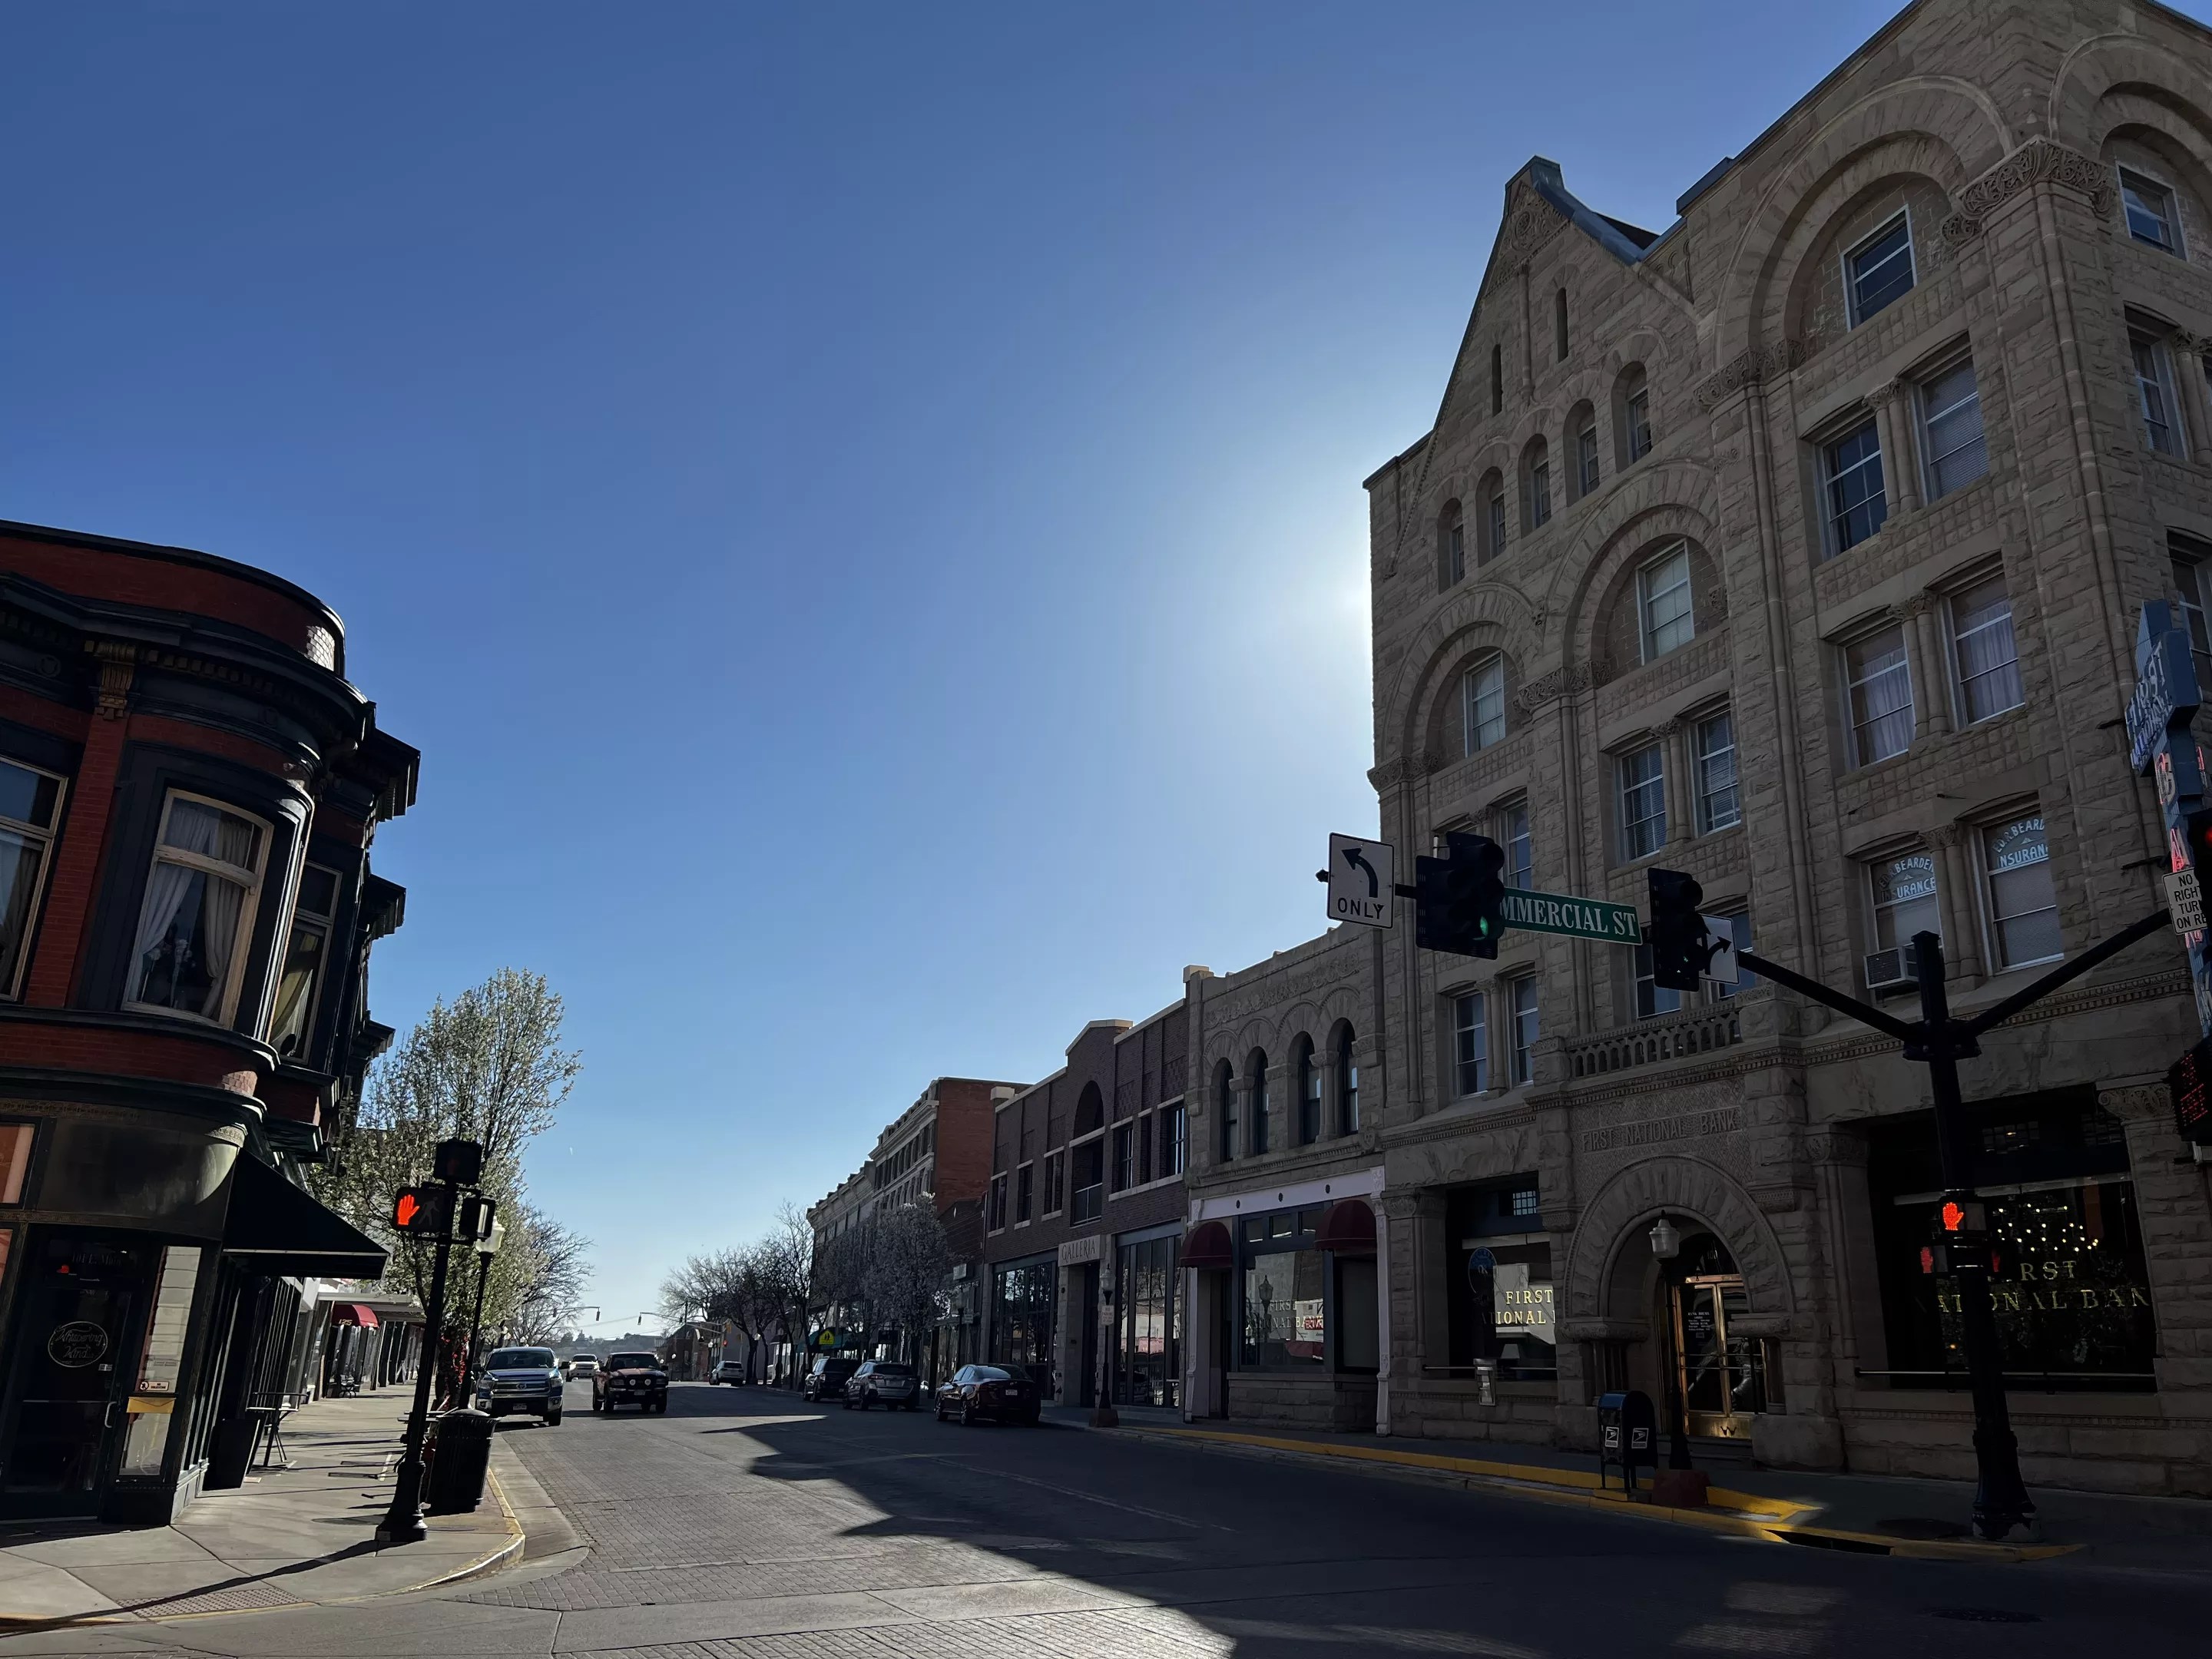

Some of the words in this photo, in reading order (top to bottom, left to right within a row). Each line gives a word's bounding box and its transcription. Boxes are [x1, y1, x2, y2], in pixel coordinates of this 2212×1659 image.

[2010, 818, 2045, 837] BEARD
[1997, 843, 2048, 868] INSURAN
[2178, 874, 2194, 886] NO
[1337, 896, 1385, 920] ONLY
[1501, 896, 1608, 932] MMERCIAL
[1612, 911, 1637, 936] ST
[2177, 916, 2192, 929] ON
[2194, 912, 2207, 926] RE
[1581, 1128, 1614, 1153] FIRST
[1626, 1116, 1687, 1147] NATIONAL
[1699, 1108, 1740, 1136] BANK
[1061, 1238, 1095, 1263] GALLERIA
[2020, 1260, 2078, 1281] RST
[1269, 1300, 1297, 1312] FIRST
[1505, 1290, 1554, 1305] FIRST
[1295, 1316, 1324, 1330] BANK
